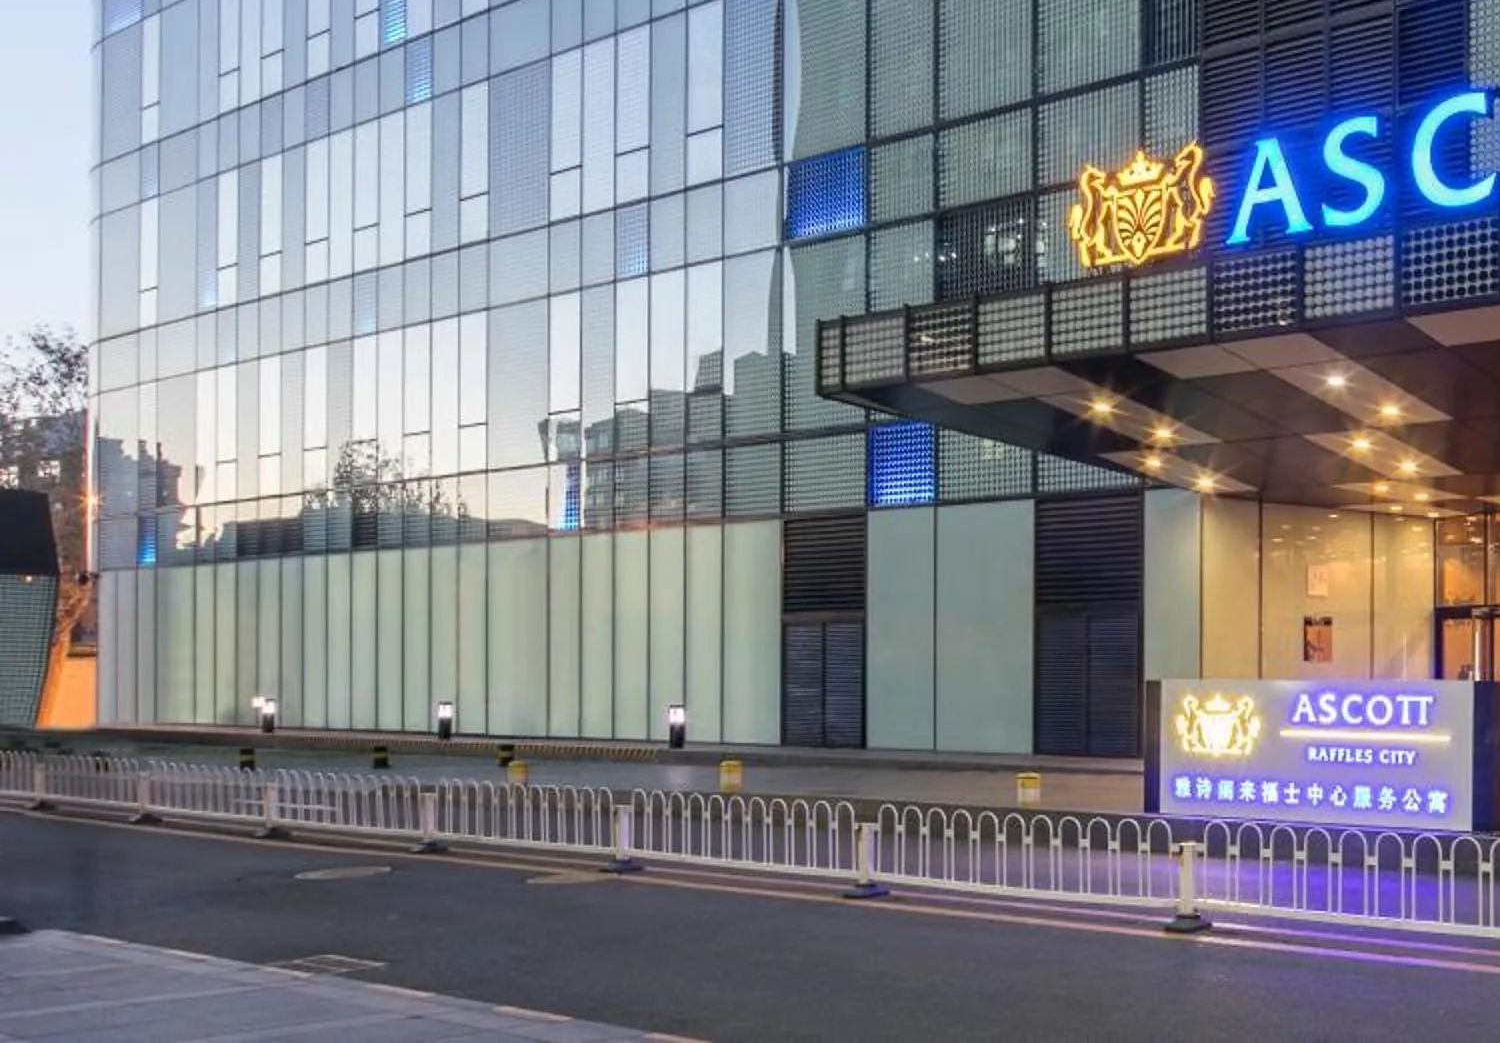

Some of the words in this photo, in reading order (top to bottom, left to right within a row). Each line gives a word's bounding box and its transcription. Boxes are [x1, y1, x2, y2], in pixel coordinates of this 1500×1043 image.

[1292, 693, 1434, 726] ASCOTT
[1308, 746, 1373, 765] RAFFLES
[1379, 750, 1416, 766] CITY
[1174, 776, 1449, 814] 雅诗阁来福士中心服务公寓
